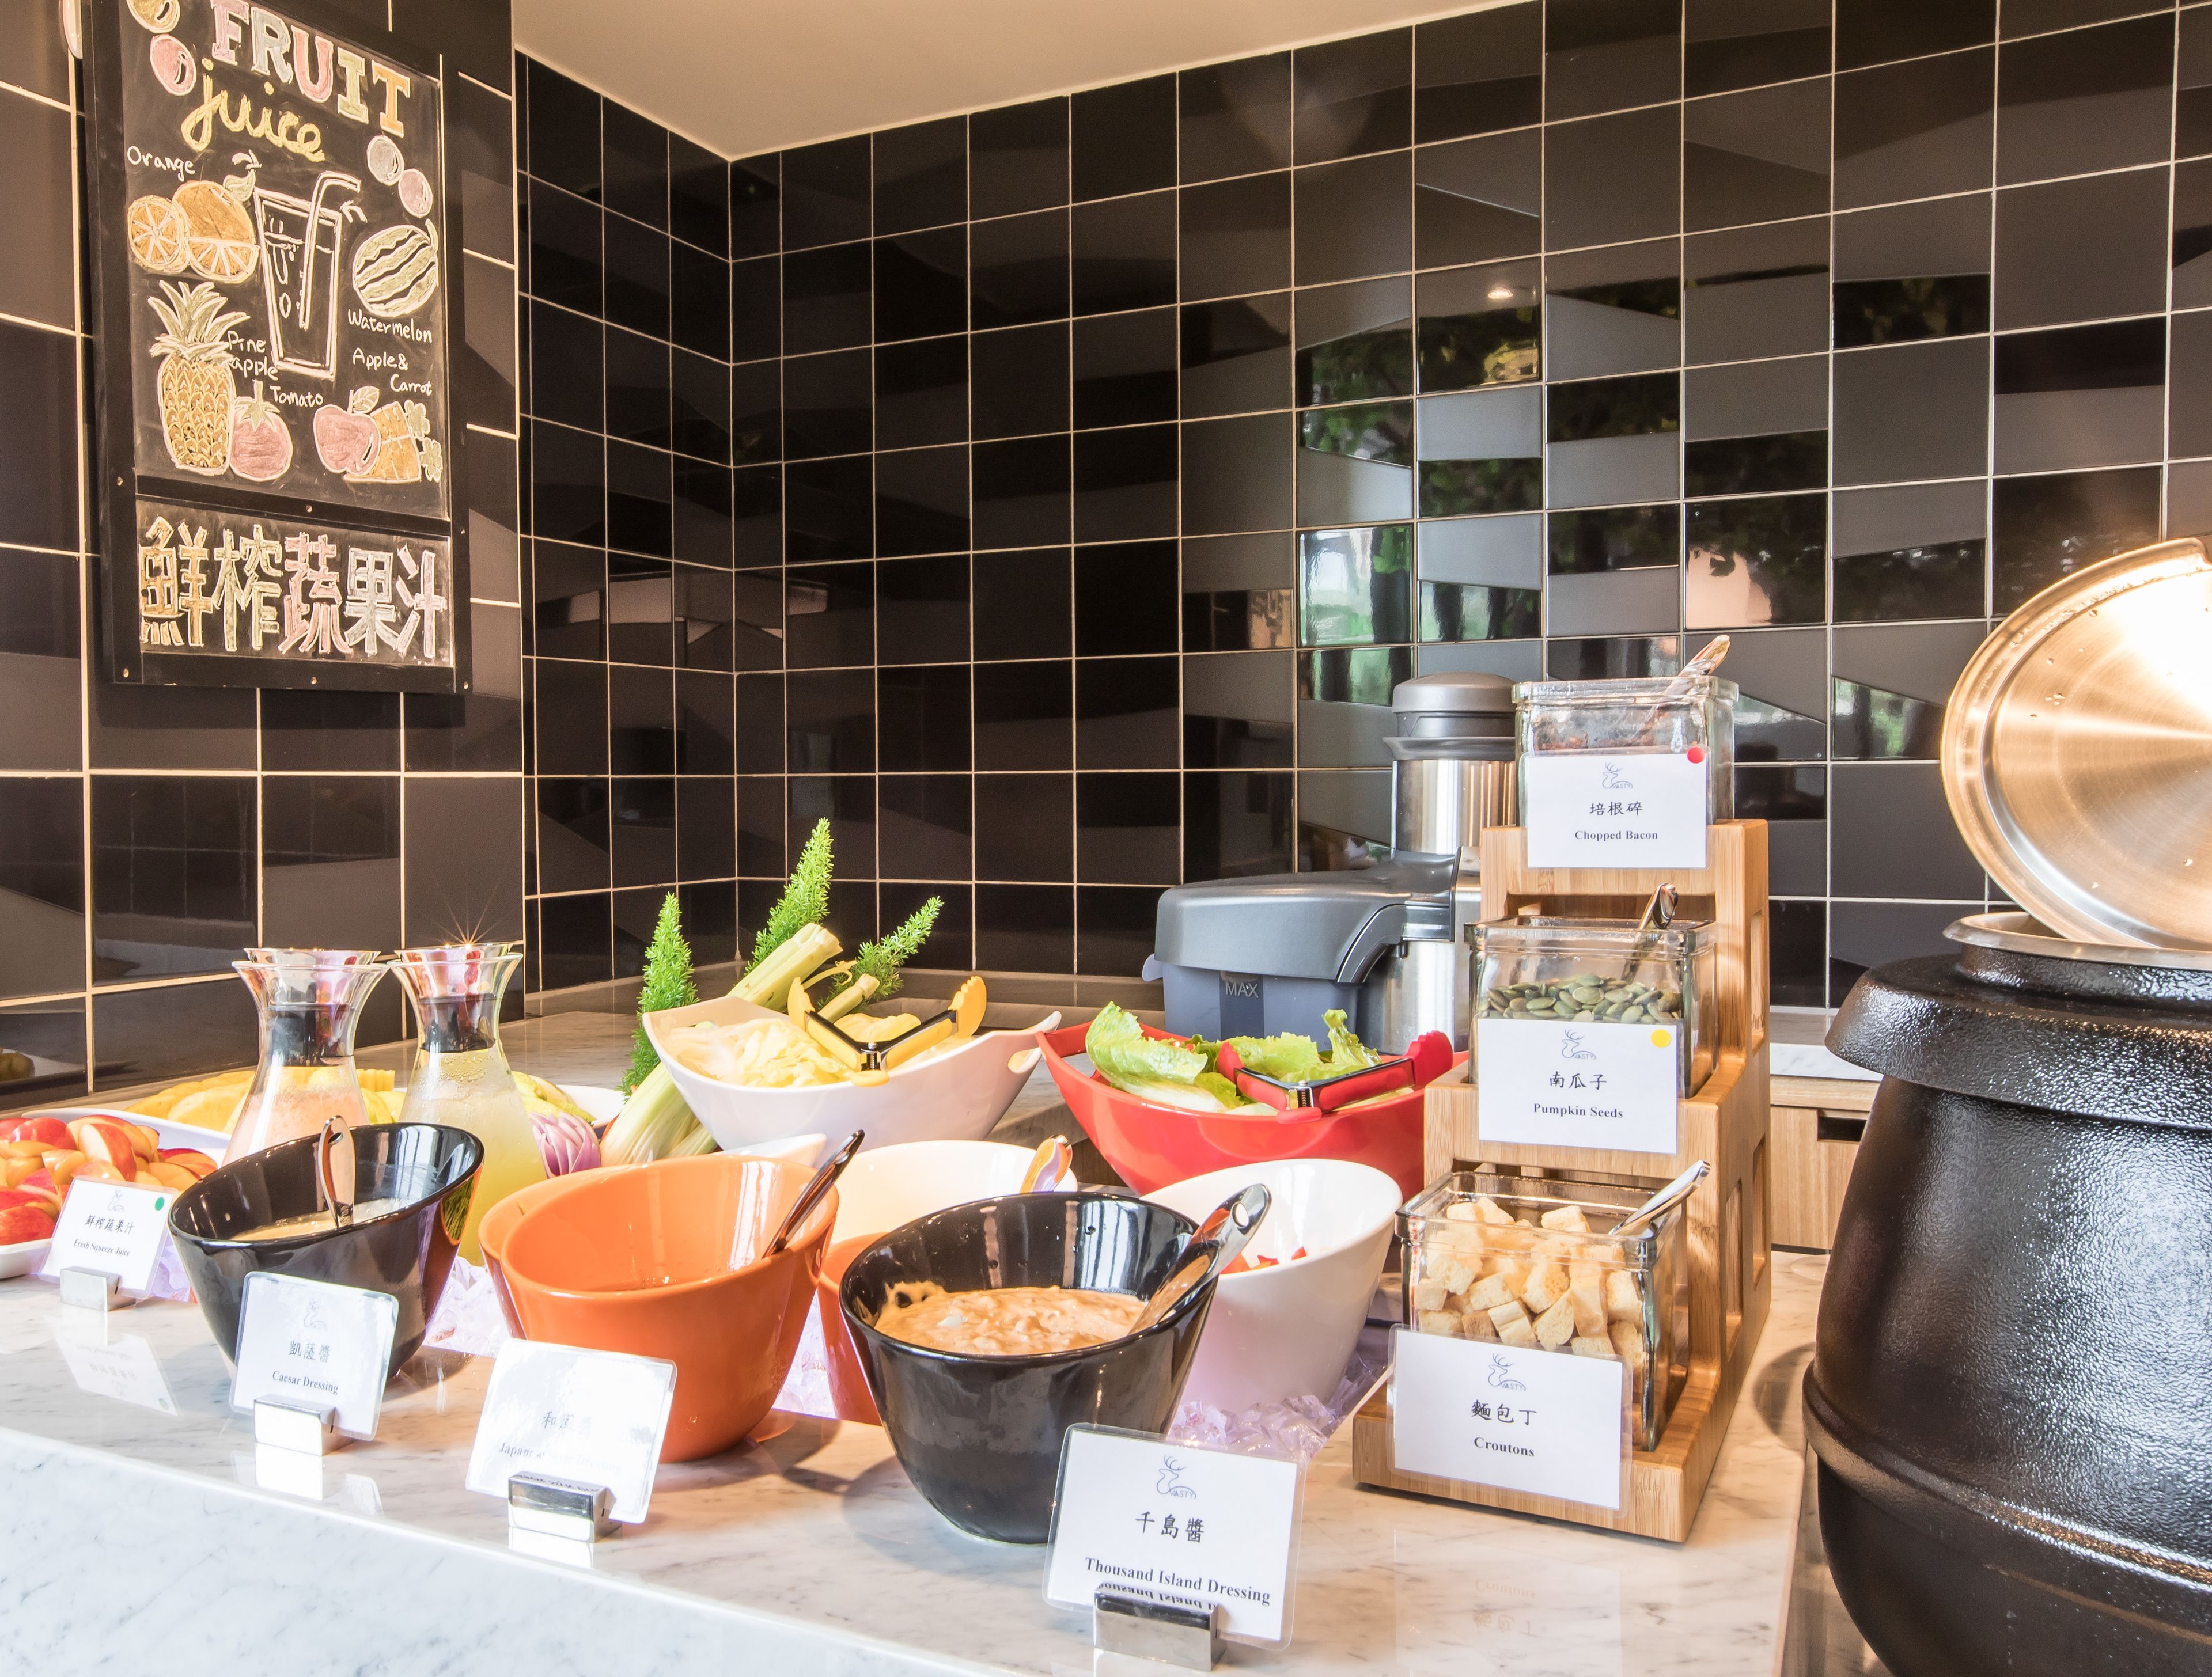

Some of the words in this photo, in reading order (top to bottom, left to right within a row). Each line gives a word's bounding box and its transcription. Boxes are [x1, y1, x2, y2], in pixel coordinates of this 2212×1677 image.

[210, 0, 411, 138] FRUIT
[181, 58, 325, 162] juice
[127, 146, 196, 181] Orange
[347, 310, 433, 343] Watermelon
[228, 331, 266, 353] Pine
[232, 356, 278, 381] apple
[389, 373, 433, 396] Carrot
[269, 385, 324, 408] Tomato
[139, 516, 448, 659] 鮮榨蔬果汁
[1589, 800, 1643, 817] 培根碎
[1575, 830, 1622, 841] Chopped
[1626, 830, 1658, 840] Bacon
[1225, 980, 1259, 998] MAX
[1550, 1071, 1607, 1090] 南瓜子
[1533, 1103, 1586, 1117] Pumpkin
[1590, 1107, 1623, 1118] Seeds
[74, 1239, 89, 1249] Fresh
[91, 1242, 114, 1254] Squeeze
[115, 1247, 130, 1257] Juice
[288, 1340, 331, 1363] 凱薩醬
[272, 1370, 300, 1386] Caesar
[302, 1376, 339, 1395] Dressing
[1502, 1382, 1524, 1391] VASTY
[1471, 1399, 1537, 1426] 麵包丁
[1474, 1436, 1535, 1458] Croutons
[1171, 1489, 1195, 1498] VASTY
[1135, 1511, 1205, 1543] 千島醬
[1085, 1557, 1153, 1583] Thousand
[1159, 1570, 1202, 1591] Island
[1208, 1579, 1271, 1606] Dressing
